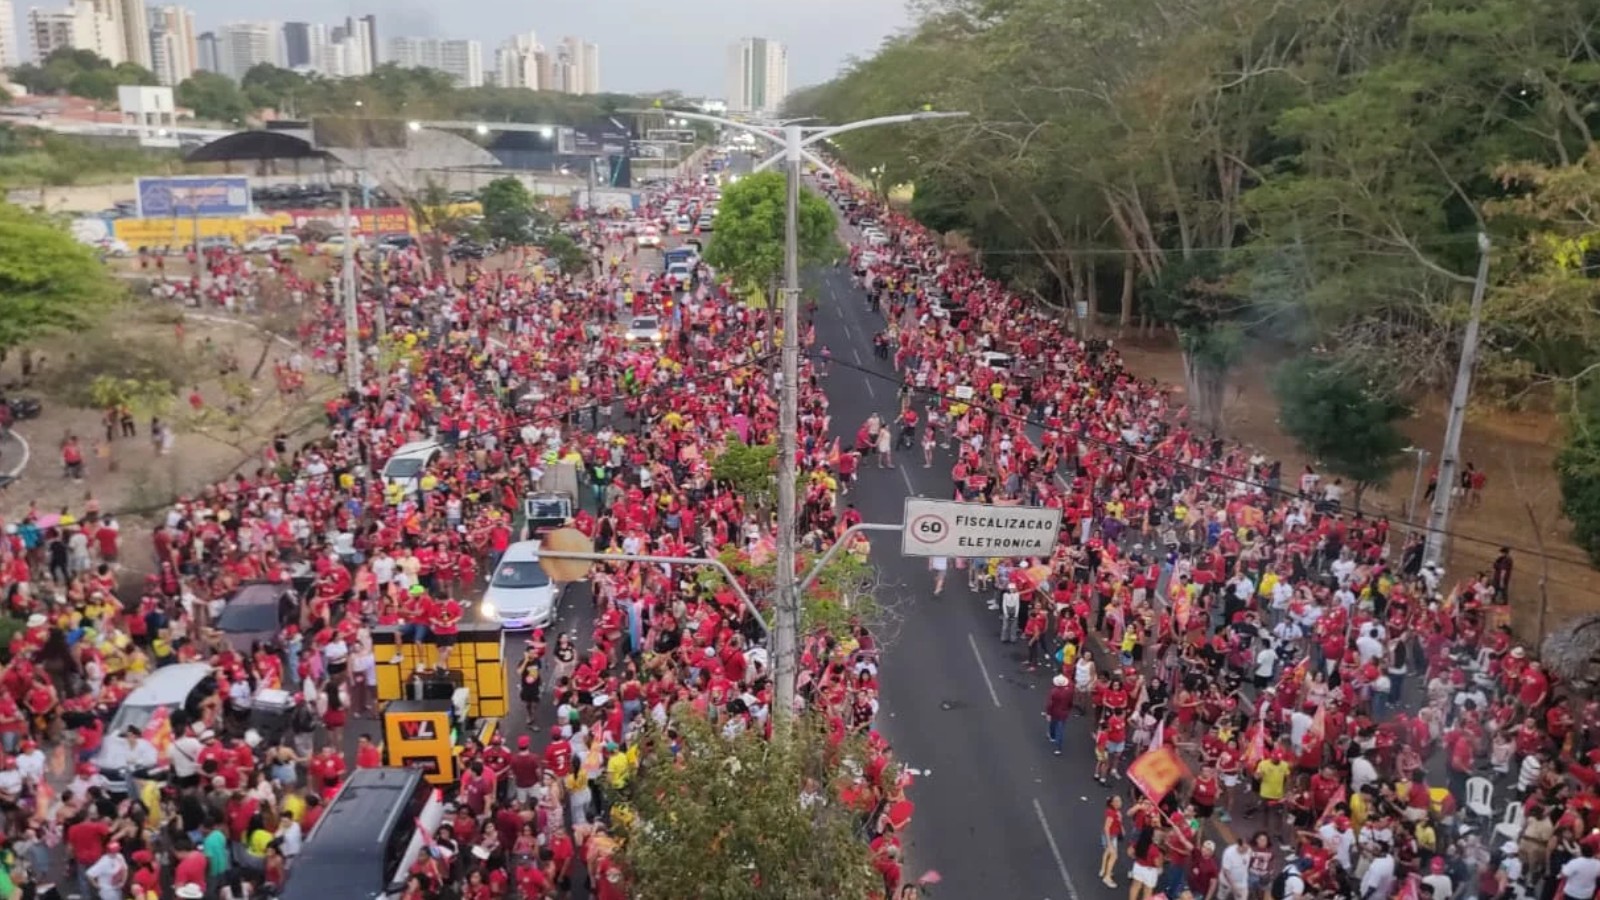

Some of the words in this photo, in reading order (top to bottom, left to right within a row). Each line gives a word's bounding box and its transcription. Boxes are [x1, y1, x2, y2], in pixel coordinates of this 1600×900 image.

[920, 521, 942, 533] 60
[958, 536, 1041, 548] ELETRONICA
[401, 720, 434, 737] WL
